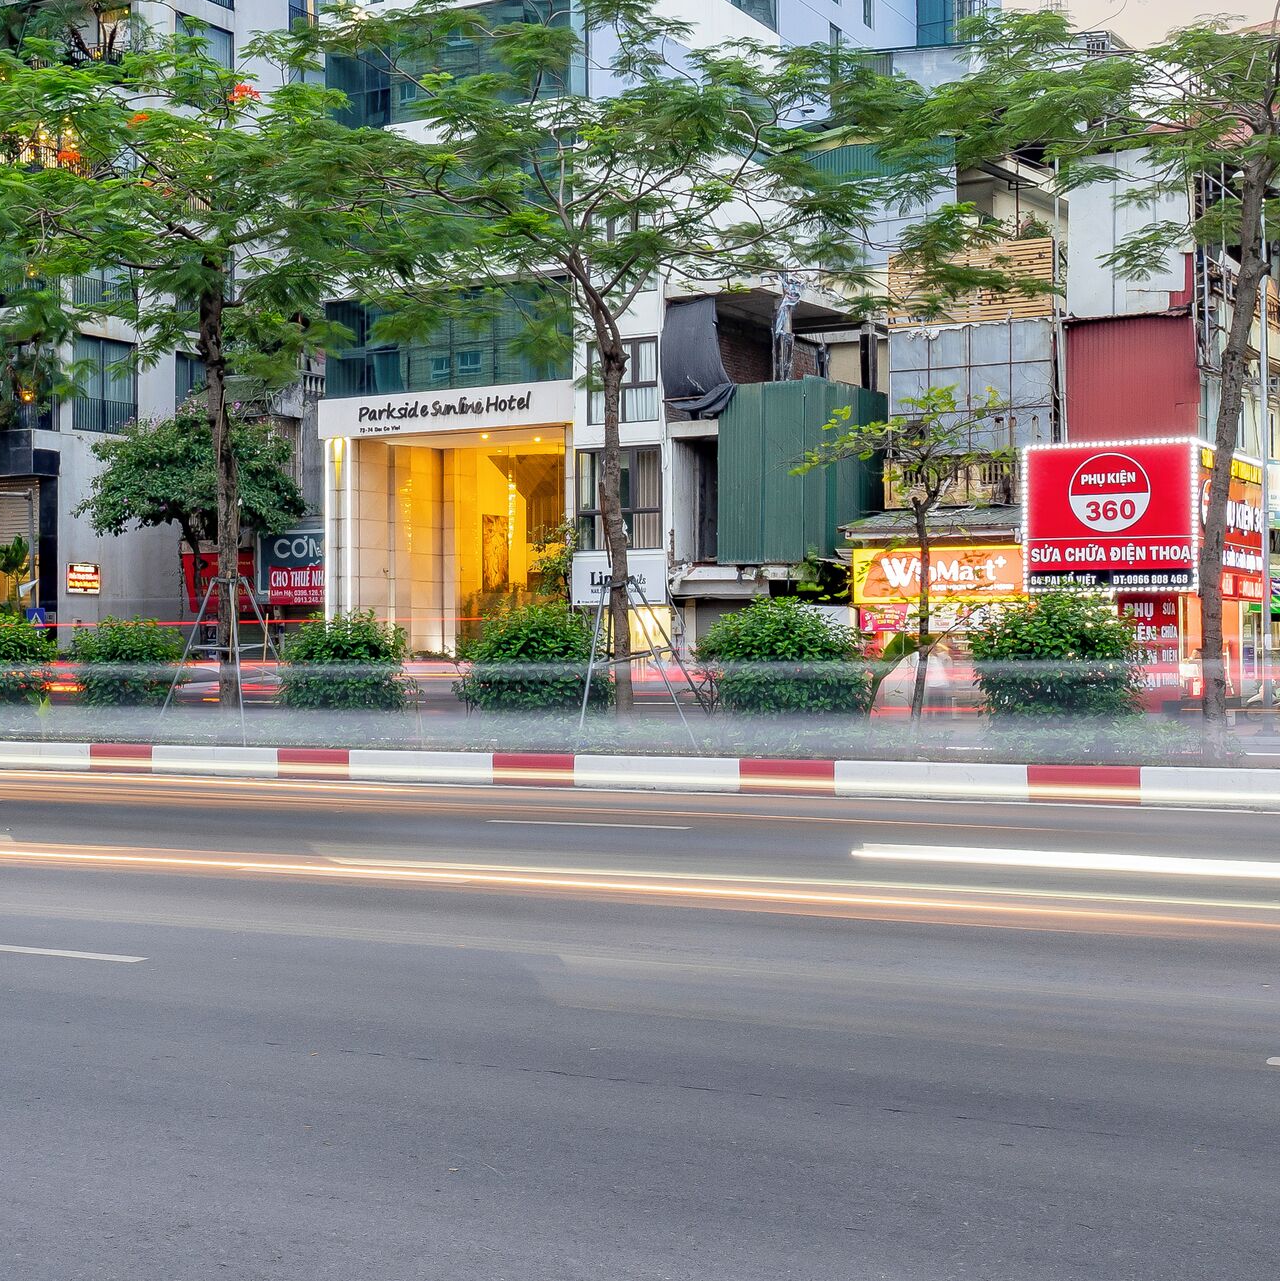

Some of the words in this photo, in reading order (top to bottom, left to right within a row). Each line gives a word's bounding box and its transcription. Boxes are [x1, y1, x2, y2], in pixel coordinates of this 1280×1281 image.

[358, 400, 429, 423] Parkside
[485, 390, 532, 414] Hotel
[1080, 473, 1106, 487] PHỤ
[1107, 470, 1136, 487] KIỆN
[1085, 499, 1136, 521] 360
[1030, 543, 1062, 562] SỬA
[1064, 543, 1107, 562] CHỮA
[1109, 543, 1147, 565] ĐIỆN
[271, 570, 289, 587] CHO
[311, 570, 325, 587] NH
[1112, 574, 1149, 585] ĐT:0966
[1151, 574, 1169, 585] 808
[1170, 574, 1188, 584] 468
